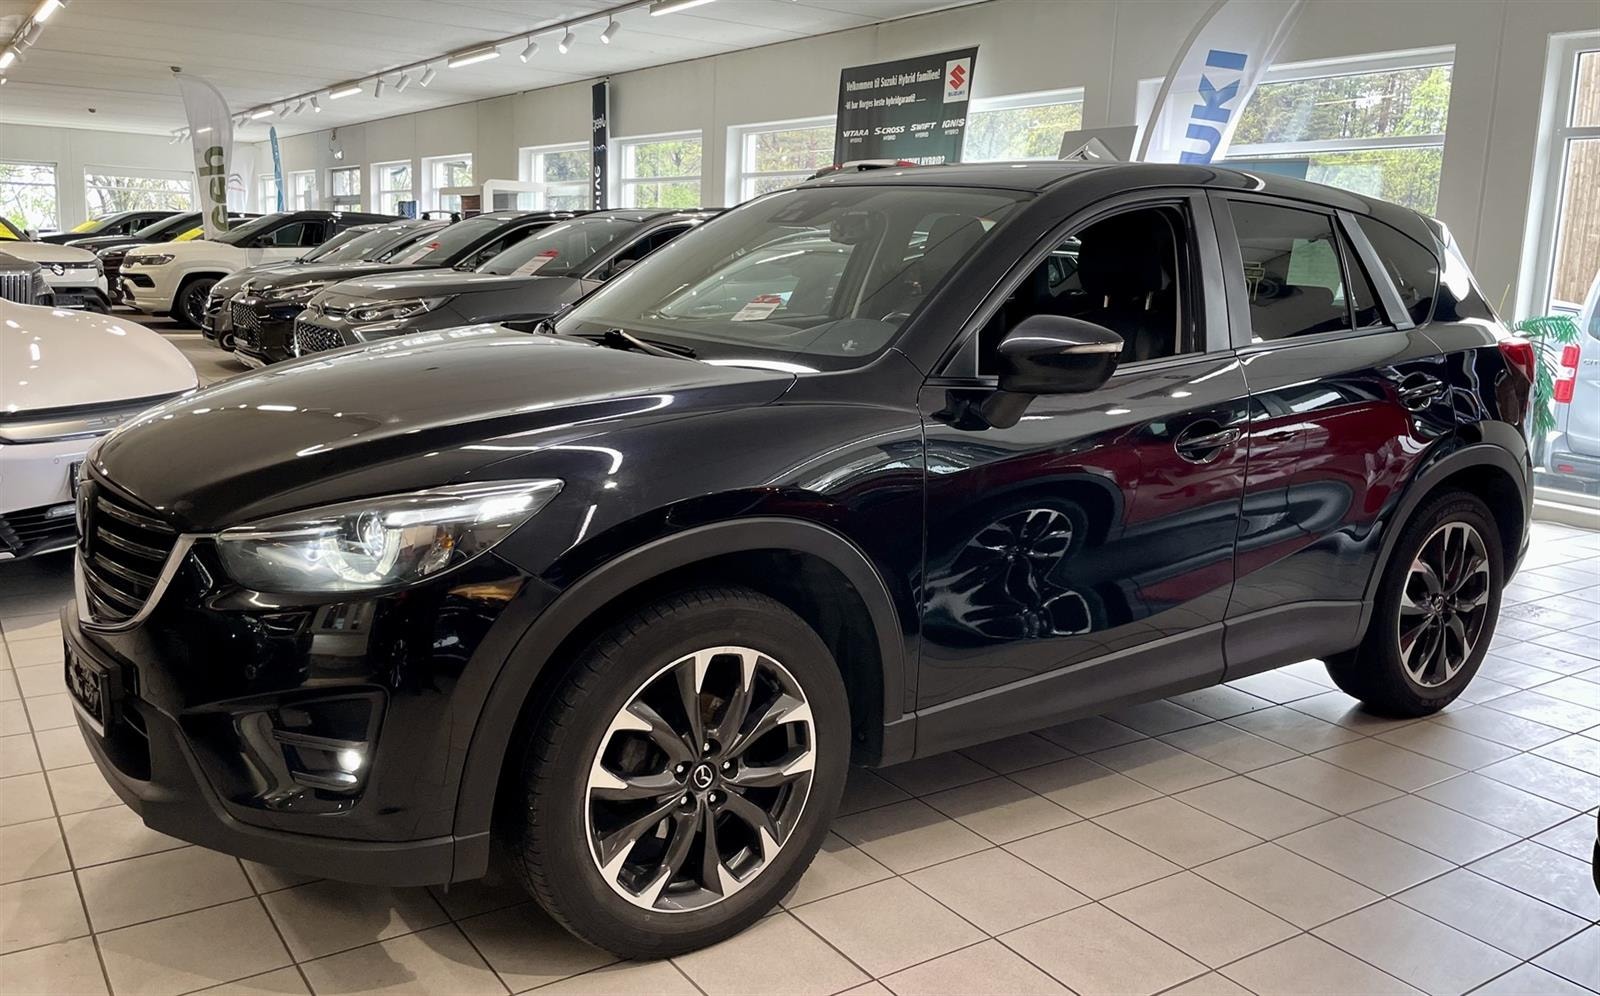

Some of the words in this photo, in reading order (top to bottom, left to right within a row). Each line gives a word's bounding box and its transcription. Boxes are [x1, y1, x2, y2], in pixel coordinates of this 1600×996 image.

[846, 80, 873, 92] Velkommen
[881, 75, 898, 87] Suzuki
[899, 72, 916, 86] Hybrid
[859, 99, 873, 110] Norges
[874, 98, 885, 106] beste
[843, 129, 869, 138] VITARA
[910, 122, 937, 132] SWIFT
[941, 118, 965, 128] IGNIS
